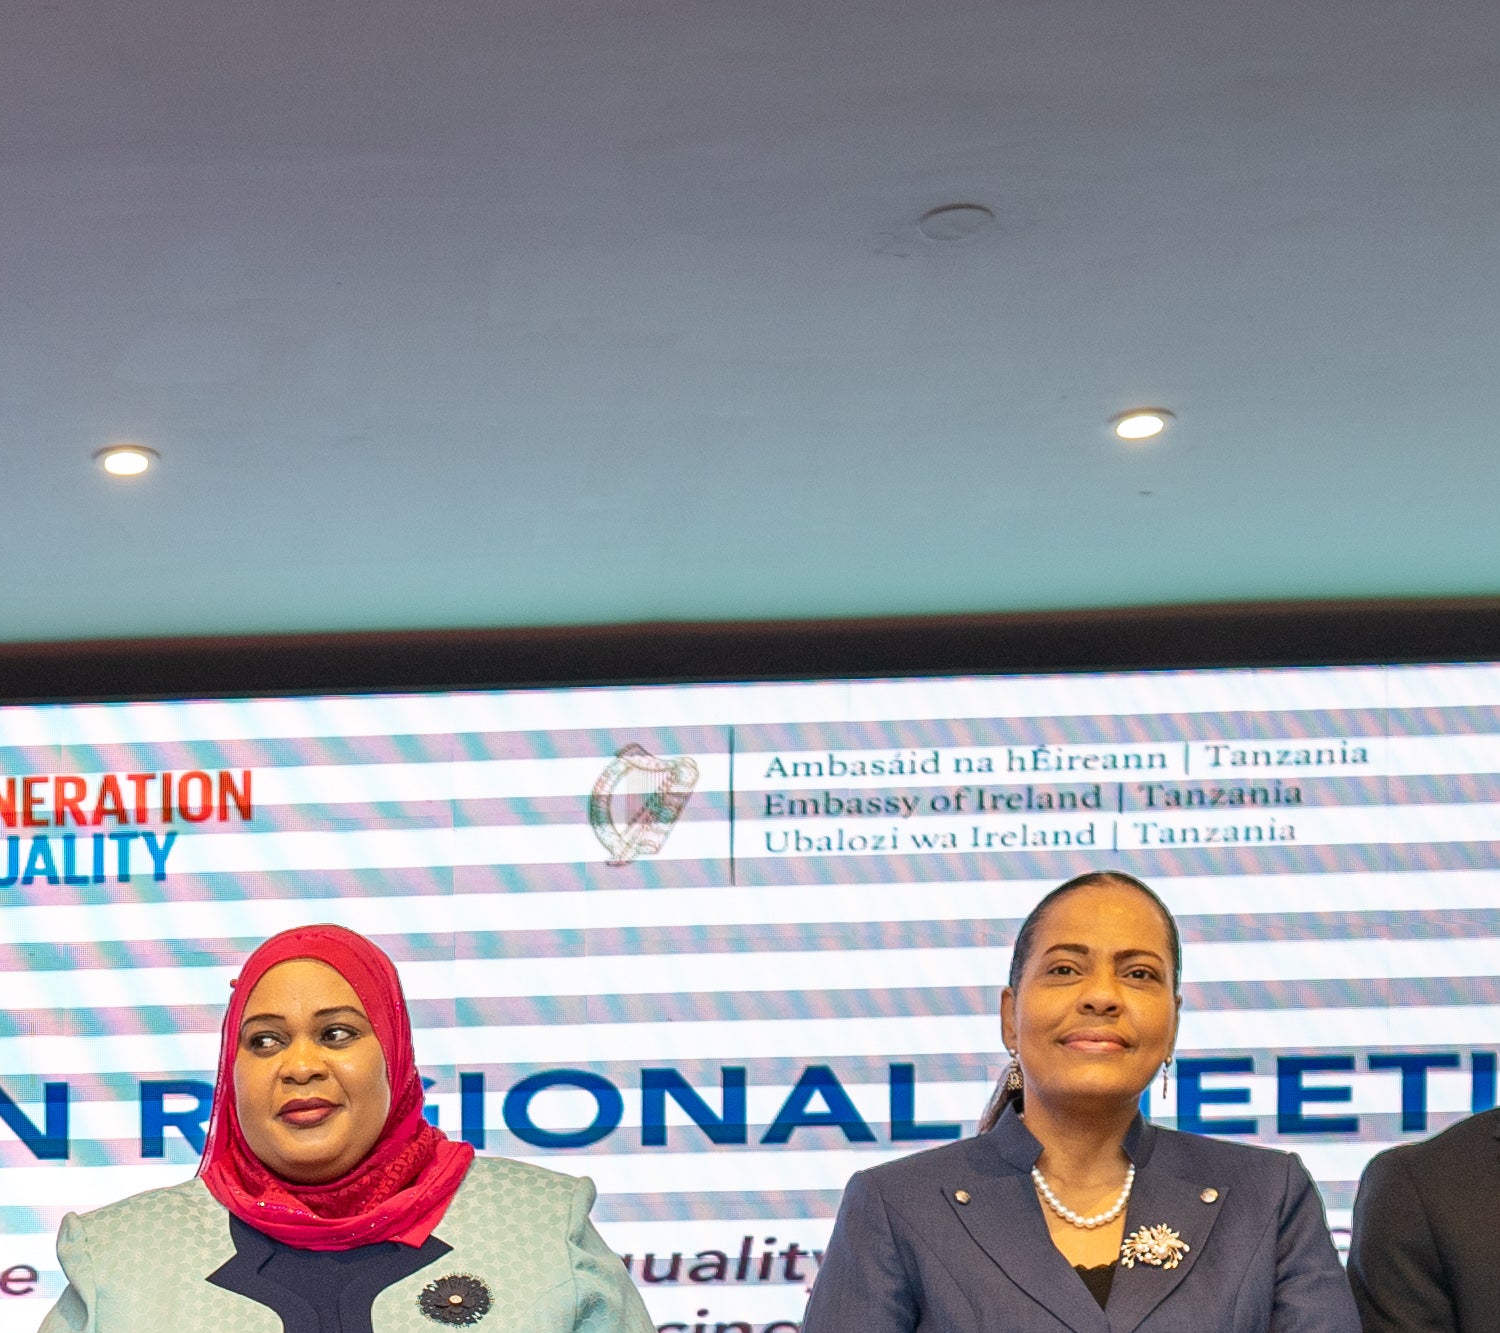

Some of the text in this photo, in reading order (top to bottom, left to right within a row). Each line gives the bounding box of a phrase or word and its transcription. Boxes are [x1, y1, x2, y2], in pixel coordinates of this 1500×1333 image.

[763, 750, 940, 778] Ambasáid
[954, 755, 994, 773] na
[1007, 744, 1168, 773] hÉireann
[1204, 740, 1369, 768] Tanzania
[763, 790, 920, 819] Embassy
[930, 786, 971, 811] of
[977, 784, 1102, 811] Ireland
[1136, 779, 1303, 808] Tanzania
[764, 827, 900, 853] Ubalozi
[910, 830, 958, 849] wa
[970, 822, 1096, 849] Ireland
[1132, 818, 1297, 845] Tanzania
